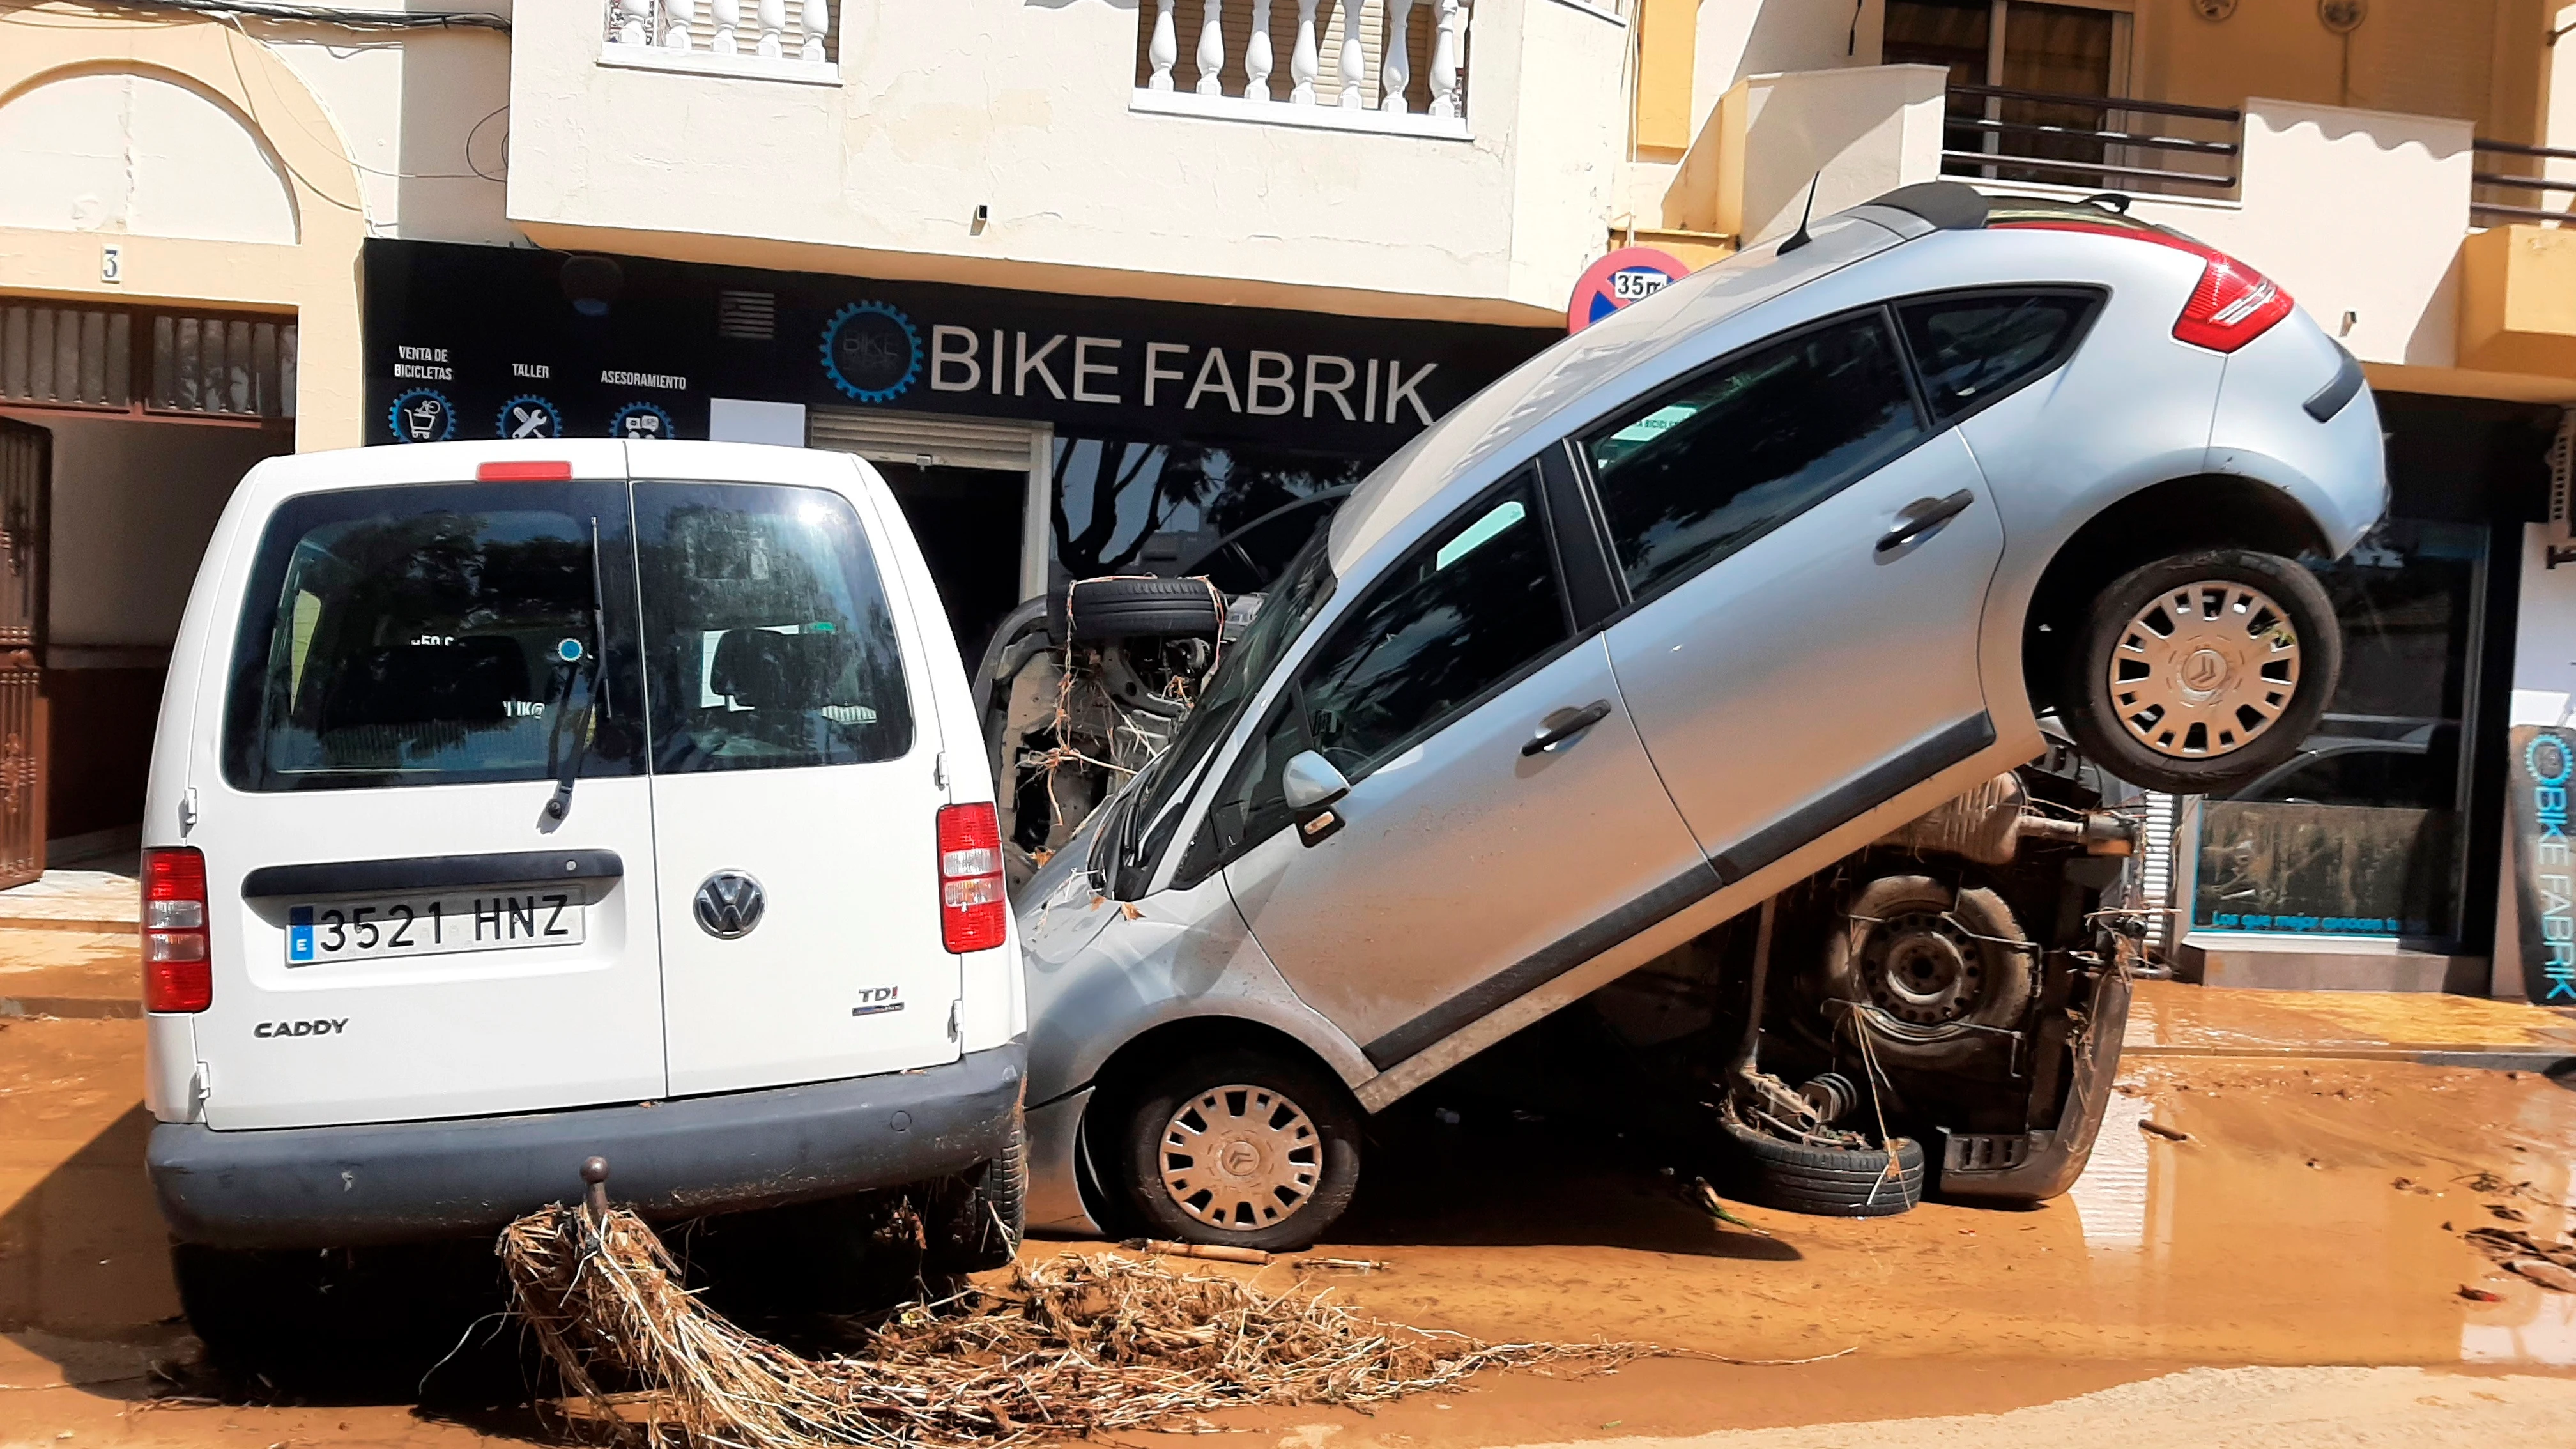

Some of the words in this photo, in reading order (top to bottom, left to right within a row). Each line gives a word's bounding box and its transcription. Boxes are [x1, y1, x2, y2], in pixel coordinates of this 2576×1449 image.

[103, 249, 118, 278] 3
[399, 344, 432, 362] VENTA
[434, 348, 448, 363] DE
[394, 363, 453, 381] BICICLETAS
[512, 363, 550, 379] TALLER
[601, 369, 687, 390] ASESORAMIENTO
[930, 324, 1123, 404] BIKE
[1144, 341, 1439, 427] FABRIK
[2534, 786, 2570, 866] BIKE
[320, 901, 441, 952] 3521
[474, 894, 569, 941] HNZ
[296, 938, 307, 952] E
[2539, 873, 2576, 1000] FABRIK
[858, 985, 898, 1003] TDI
[254, 1018, 349, 1038] CADDY
